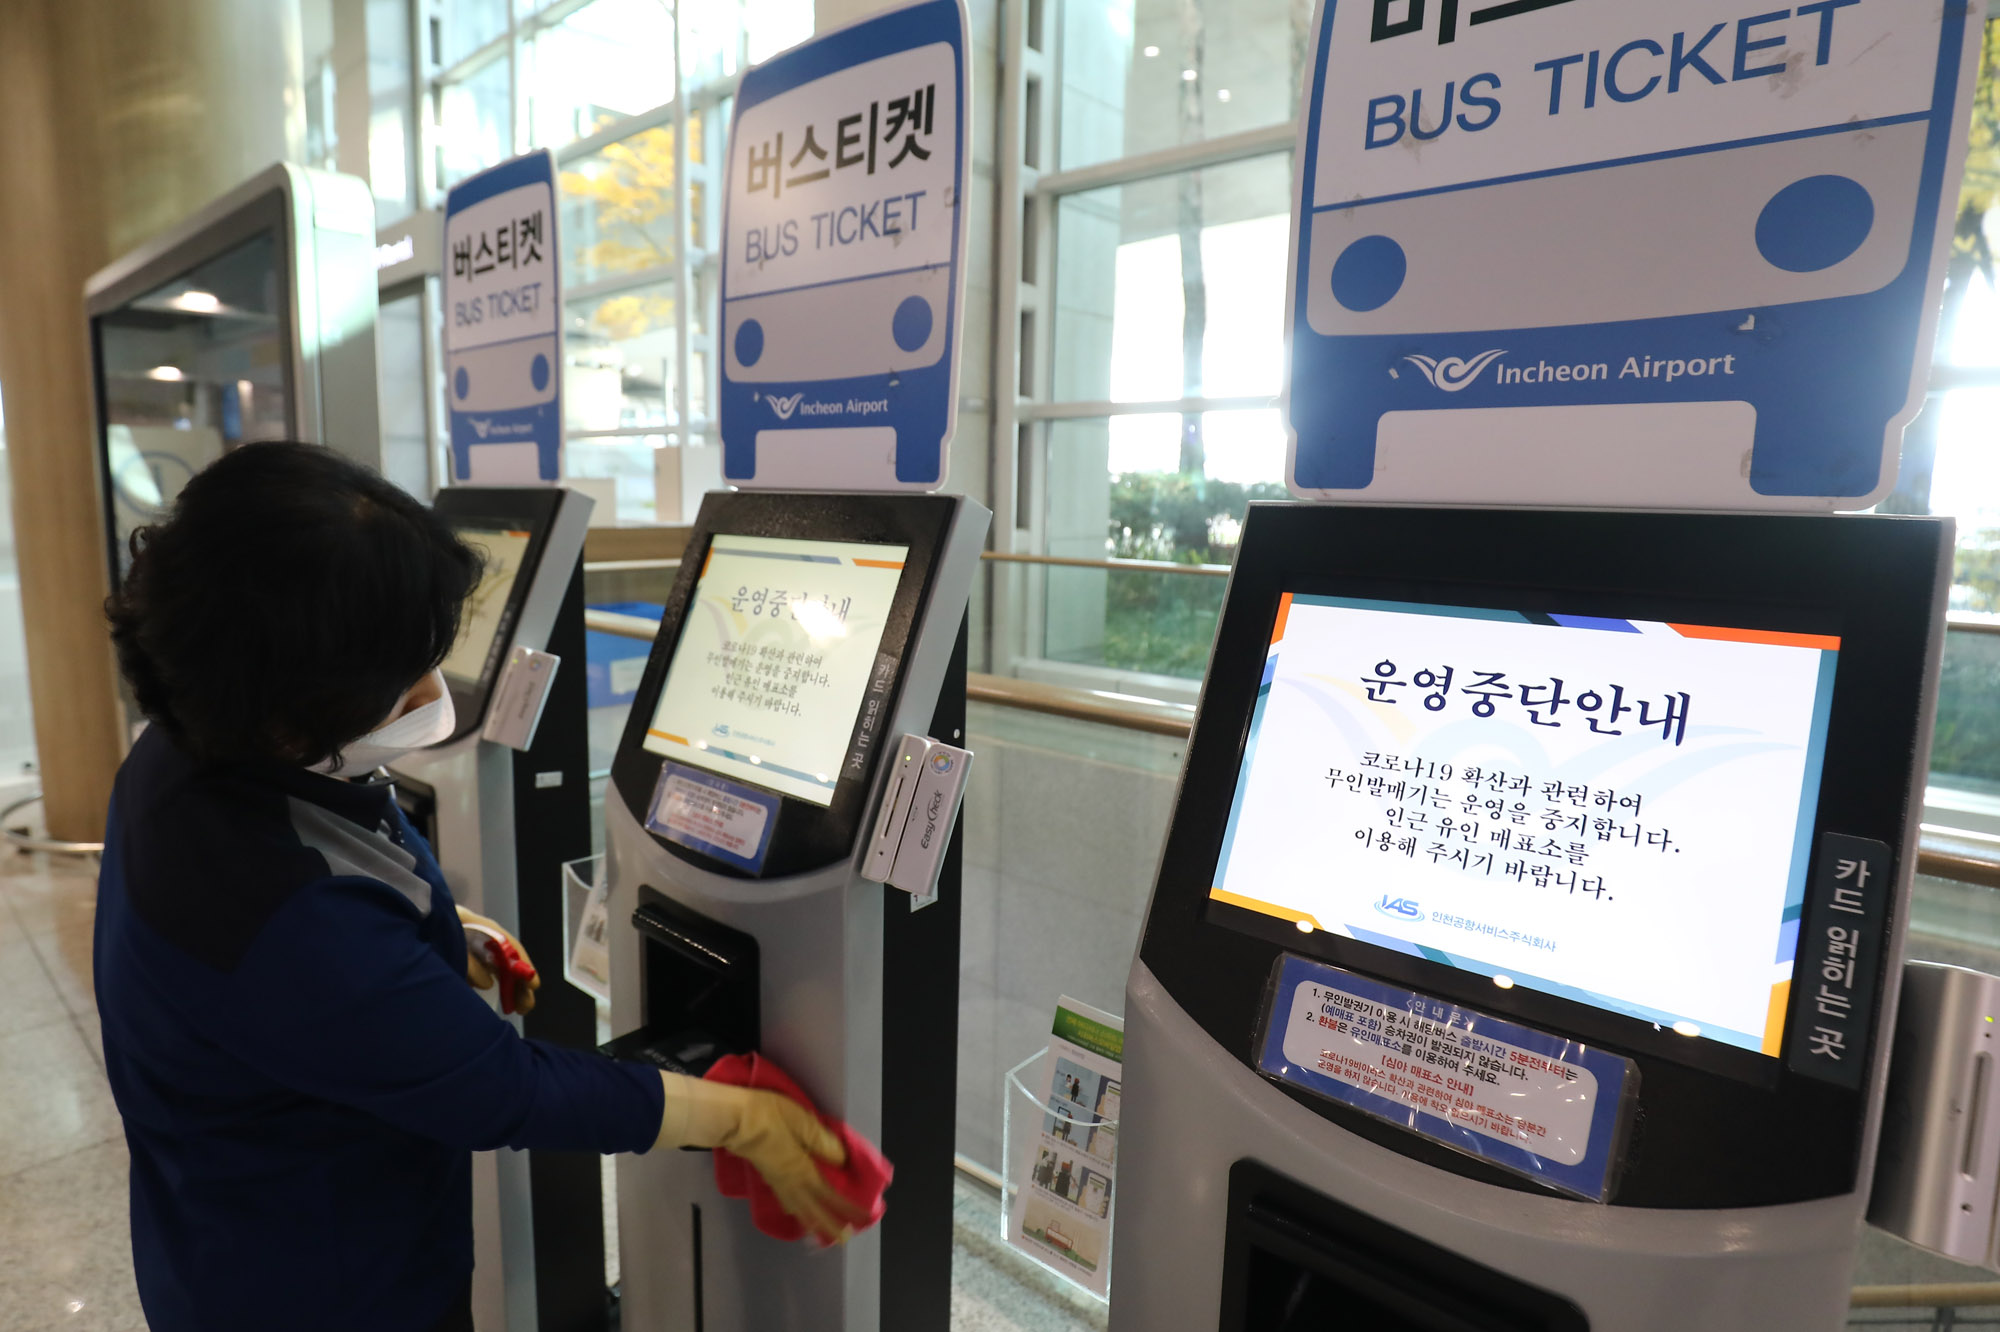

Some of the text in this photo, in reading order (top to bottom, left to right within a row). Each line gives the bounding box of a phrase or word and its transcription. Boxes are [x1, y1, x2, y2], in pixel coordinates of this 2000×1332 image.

[1365, 72, 1502, 150] BUS
[1533, 0, 1861, 116] TICKET
[747, 83, 935, 199] 버스티켓
[453, 209, 543, 282] 버스티켓
[746, 190, 927, 264] BUS TICKET
[455, 282, 542, 327] BUS TICKET
[1496, 354, 1736, 385] Incheon Airport
[800, 398, 889, 416] Incheon Airport
[851, 663, 891, 770] 카드 읽히는 곳
[1360, 659, 1691, 746] 운영중단안내
[1324, 767, 1680, 854] 무인발매기는 운영을 중지합니다.
[1359, 751, 1642, 818] 코로나19 확산과 관련하여
[1354, 826, 1614, 901] 이용해 주시기 바랍니다.
[1386, 806, 1590, 866] 인근 유인 매표소를
[1381, 894, 1419, 917] IAS
[1431, 911, 1557, 953] 인천공항서비스주식회사
[1808, 858, 1871, 1061] 카드 읽히는 곳
[1306, 1011, 1500, 1086] 2. 환불은 유인매표소를 이용하여 주세요.
[1312, 987, 1578, 1082] 1. 무인발권기 이용 시 해당버스 출발시간 5분전부터는
[1321, 1002, 1529, 1081] (예매표 포함) 승차권이 발권되지 않습니다.
[1344, 1068, 1361, 1082] 하지
[1363, 1075, 1399, 1096] 않습니다.
[1410, 1066, 1443, 1085] 매표소
[1417, 1083, 1453, 1103] 관련하여
[1455, 1096, 1474, 1110] 심야
